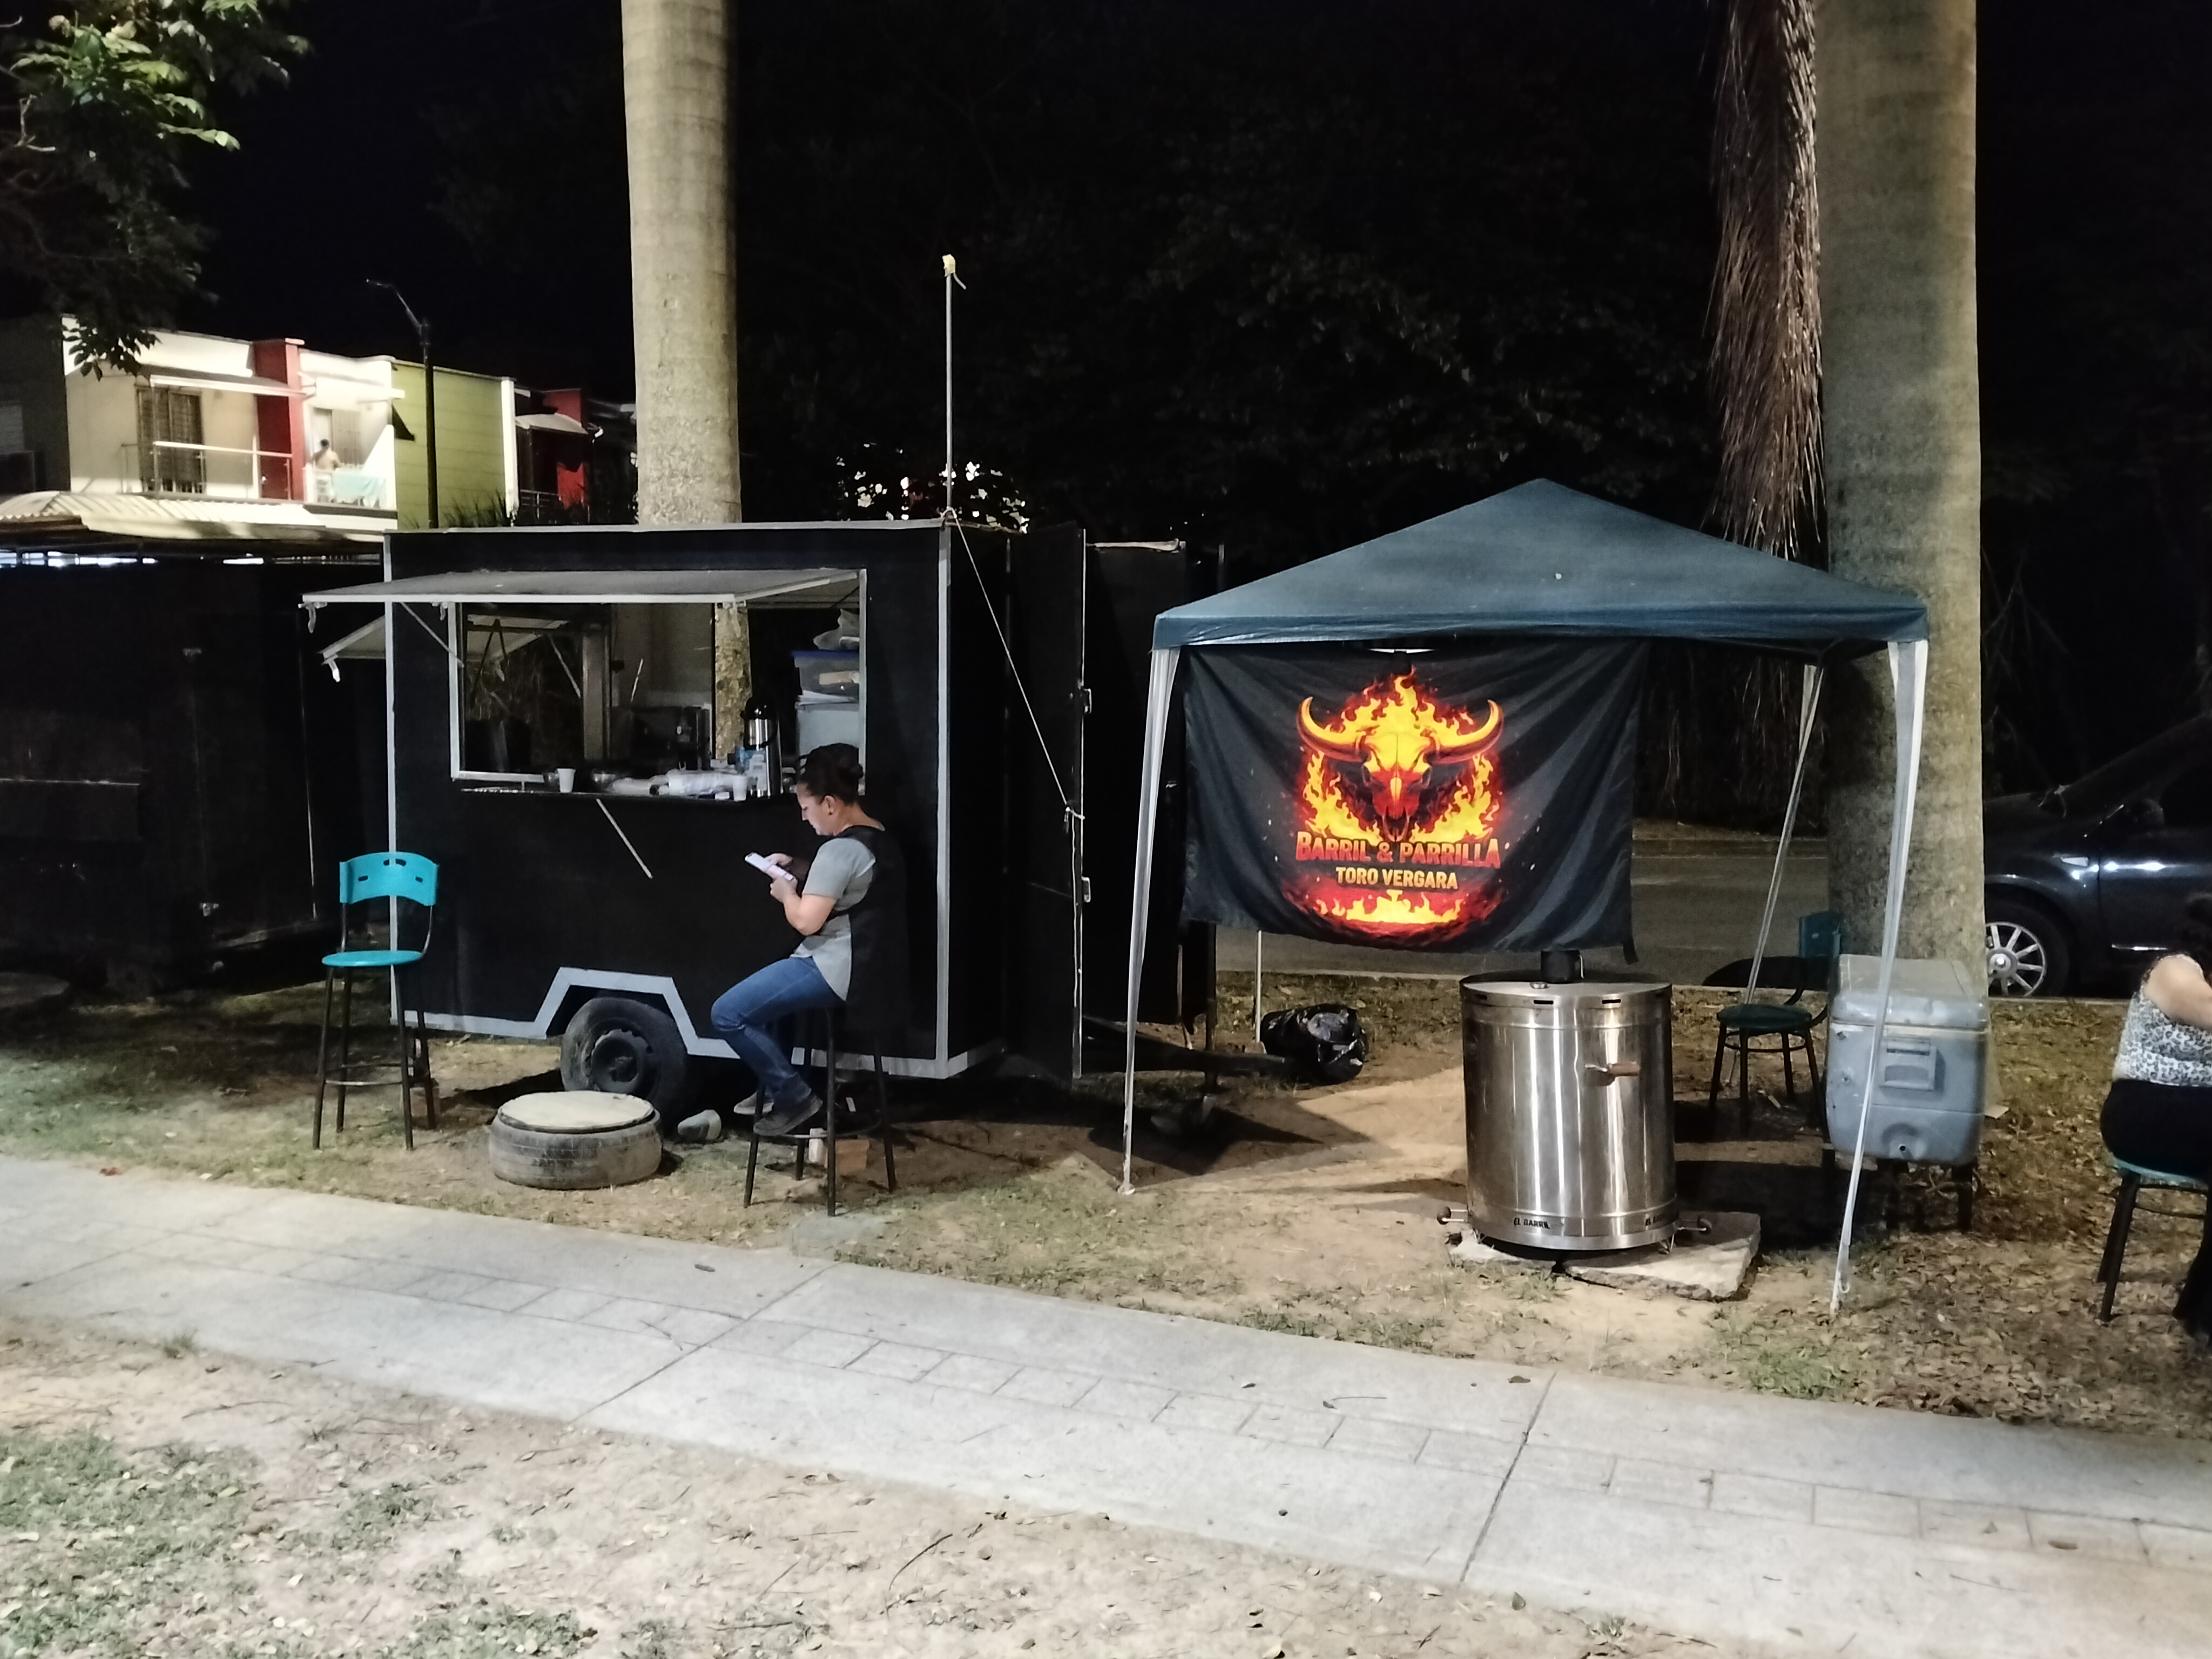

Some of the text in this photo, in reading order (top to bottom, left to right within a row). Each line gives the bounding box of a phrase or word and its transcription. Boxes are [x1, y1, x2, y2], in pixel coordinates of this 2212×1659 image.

[1296, 831, 1501, 868] BARRIL & PARRILLA
[1336, 867, 1458, 889] TORO VERGARA
